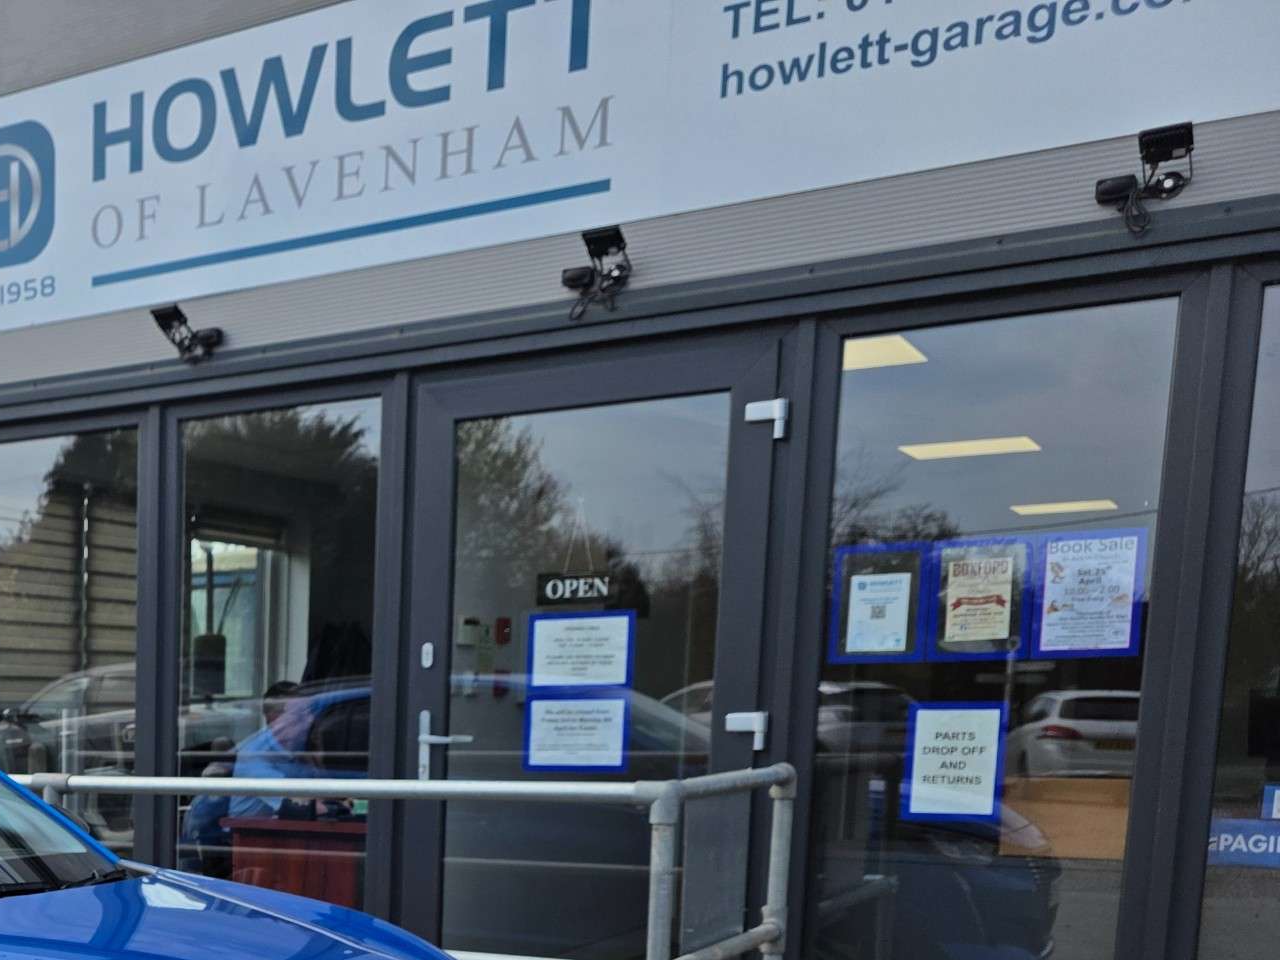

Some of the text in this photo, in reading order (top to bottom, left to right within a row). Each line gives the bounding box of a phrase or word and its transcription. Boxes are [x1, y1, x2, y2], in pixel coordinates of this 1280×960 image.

[92, 0, 592, 182] HOWLETT
[91, 95, 616, 250] OF LAVENHAM
[0, 275, 56, 305] 1958
[1049, 538, 1135, 555] Book Sale
[545, 576, 610, 600] OPEN
[935, 731, 976, 741] PARTS
[922, 745, 986, 756] DROP OFF
[940, 760, 967, 770] AND
[922, 775, 982, 785] RETURNS
[1219, 833, 1280, 854] PAGI
